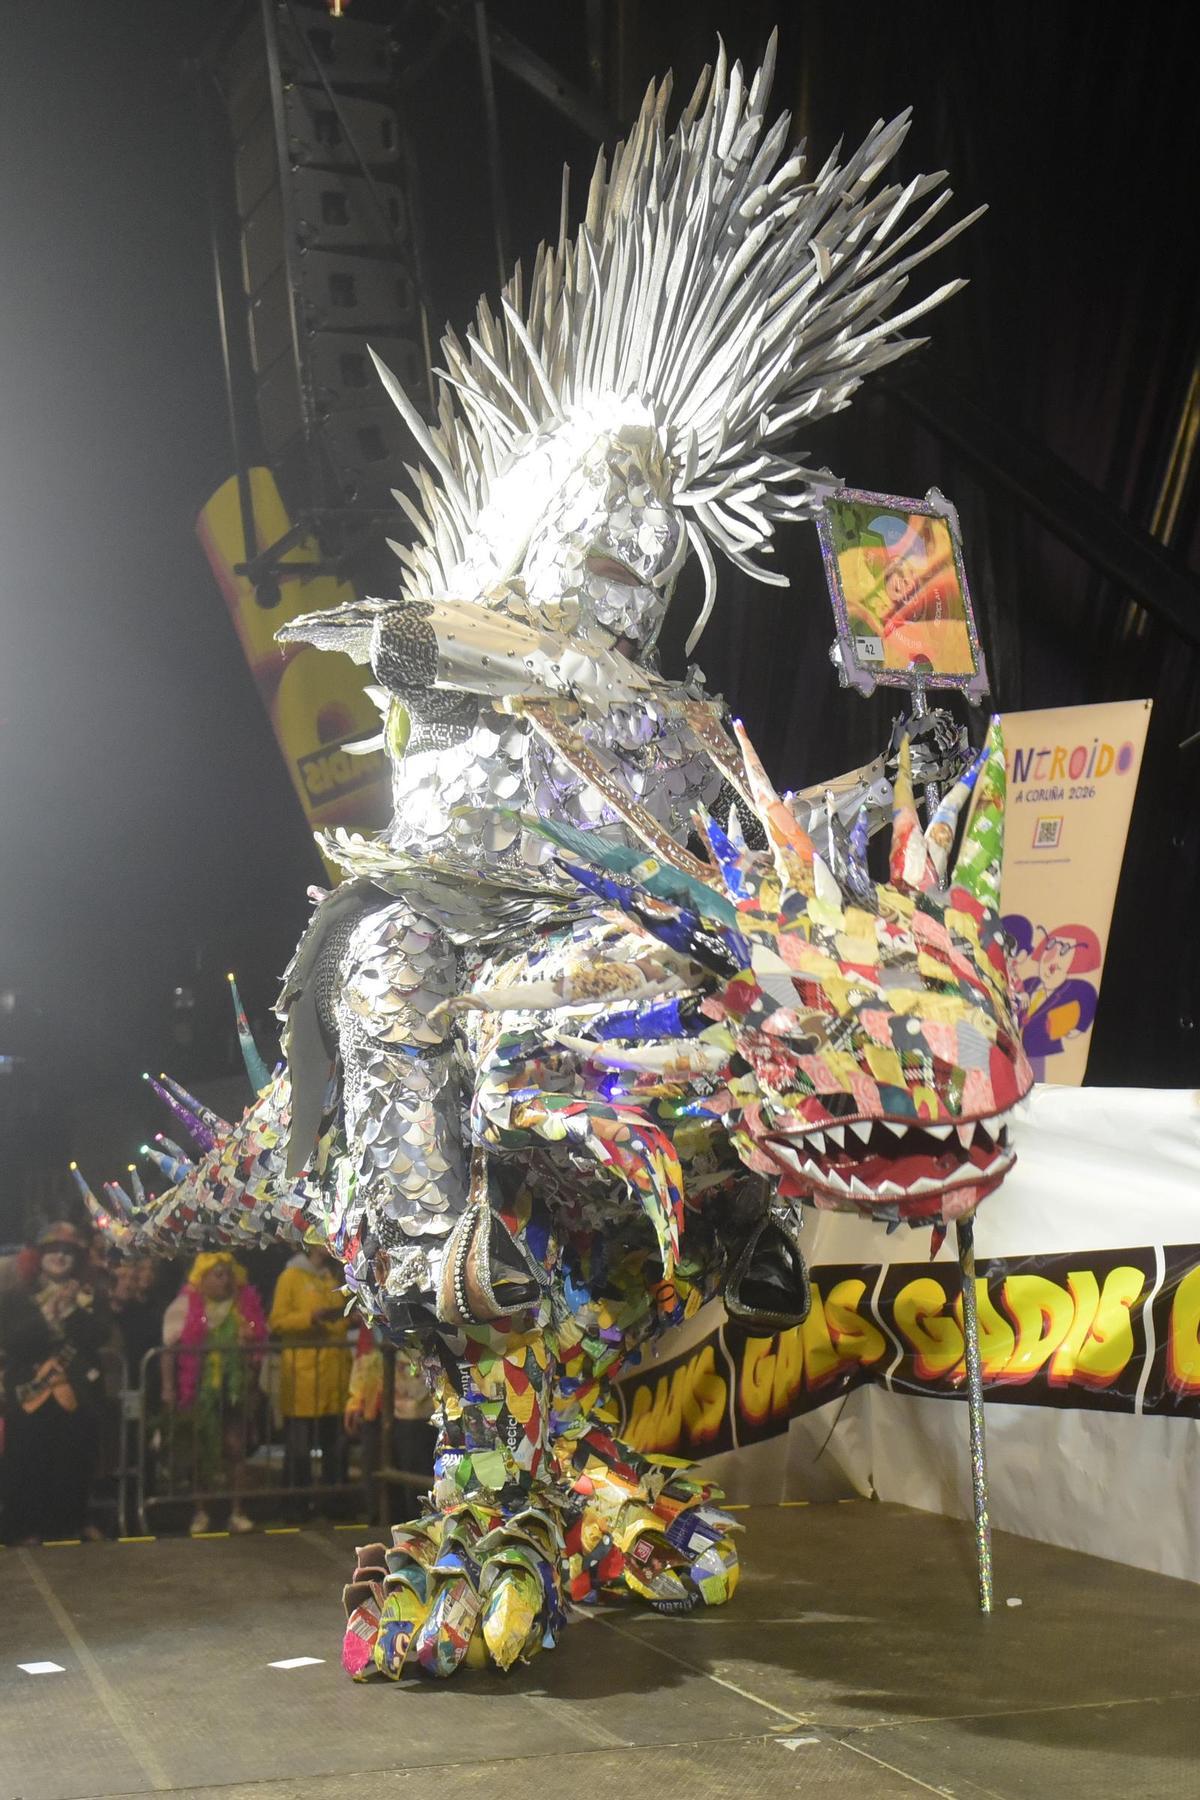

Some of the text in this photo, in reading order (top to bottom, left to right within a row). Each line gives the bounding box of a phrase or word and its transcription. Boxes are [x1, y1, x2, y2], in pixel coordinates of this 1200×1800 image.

[864, 643, 876, 655] 42
[1015, 785, 1096, 803] A CORUÑA 2026
[893, 1265, 1147, 1389] GADIS
